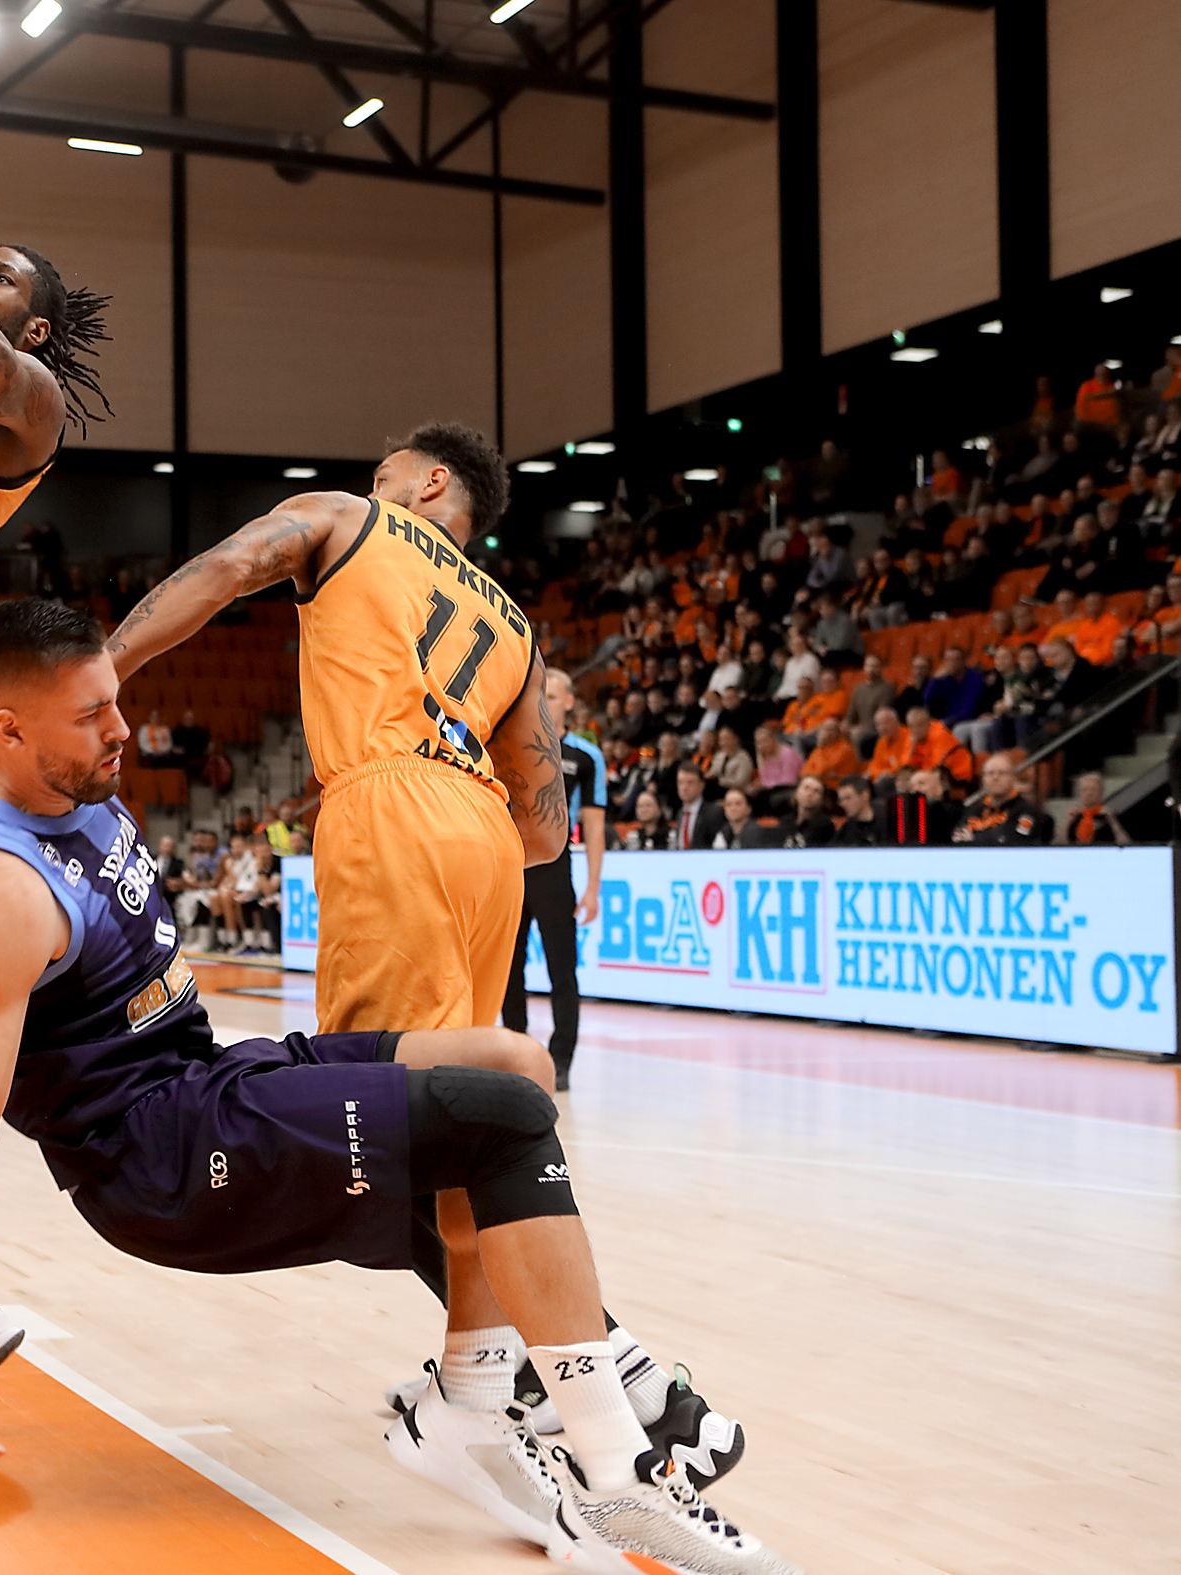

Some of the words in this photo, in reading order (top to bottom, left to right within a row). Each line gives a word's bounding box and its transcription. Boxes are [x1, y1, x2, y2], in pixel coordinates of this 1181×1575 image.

[386, 512, 529, 638] HOPKINS
[416, 585, 499, 706] 11
[598, 879, 711, 967] BeA
[734, 879, 820, 985] K-H
[835, 880, 1088, 941] KIINNIKE-
[836, 939, 1077, 1006] HEINONEN
[1091, 952, 1167, 1013] OY
[554, 1355, 595, 1382] 23
